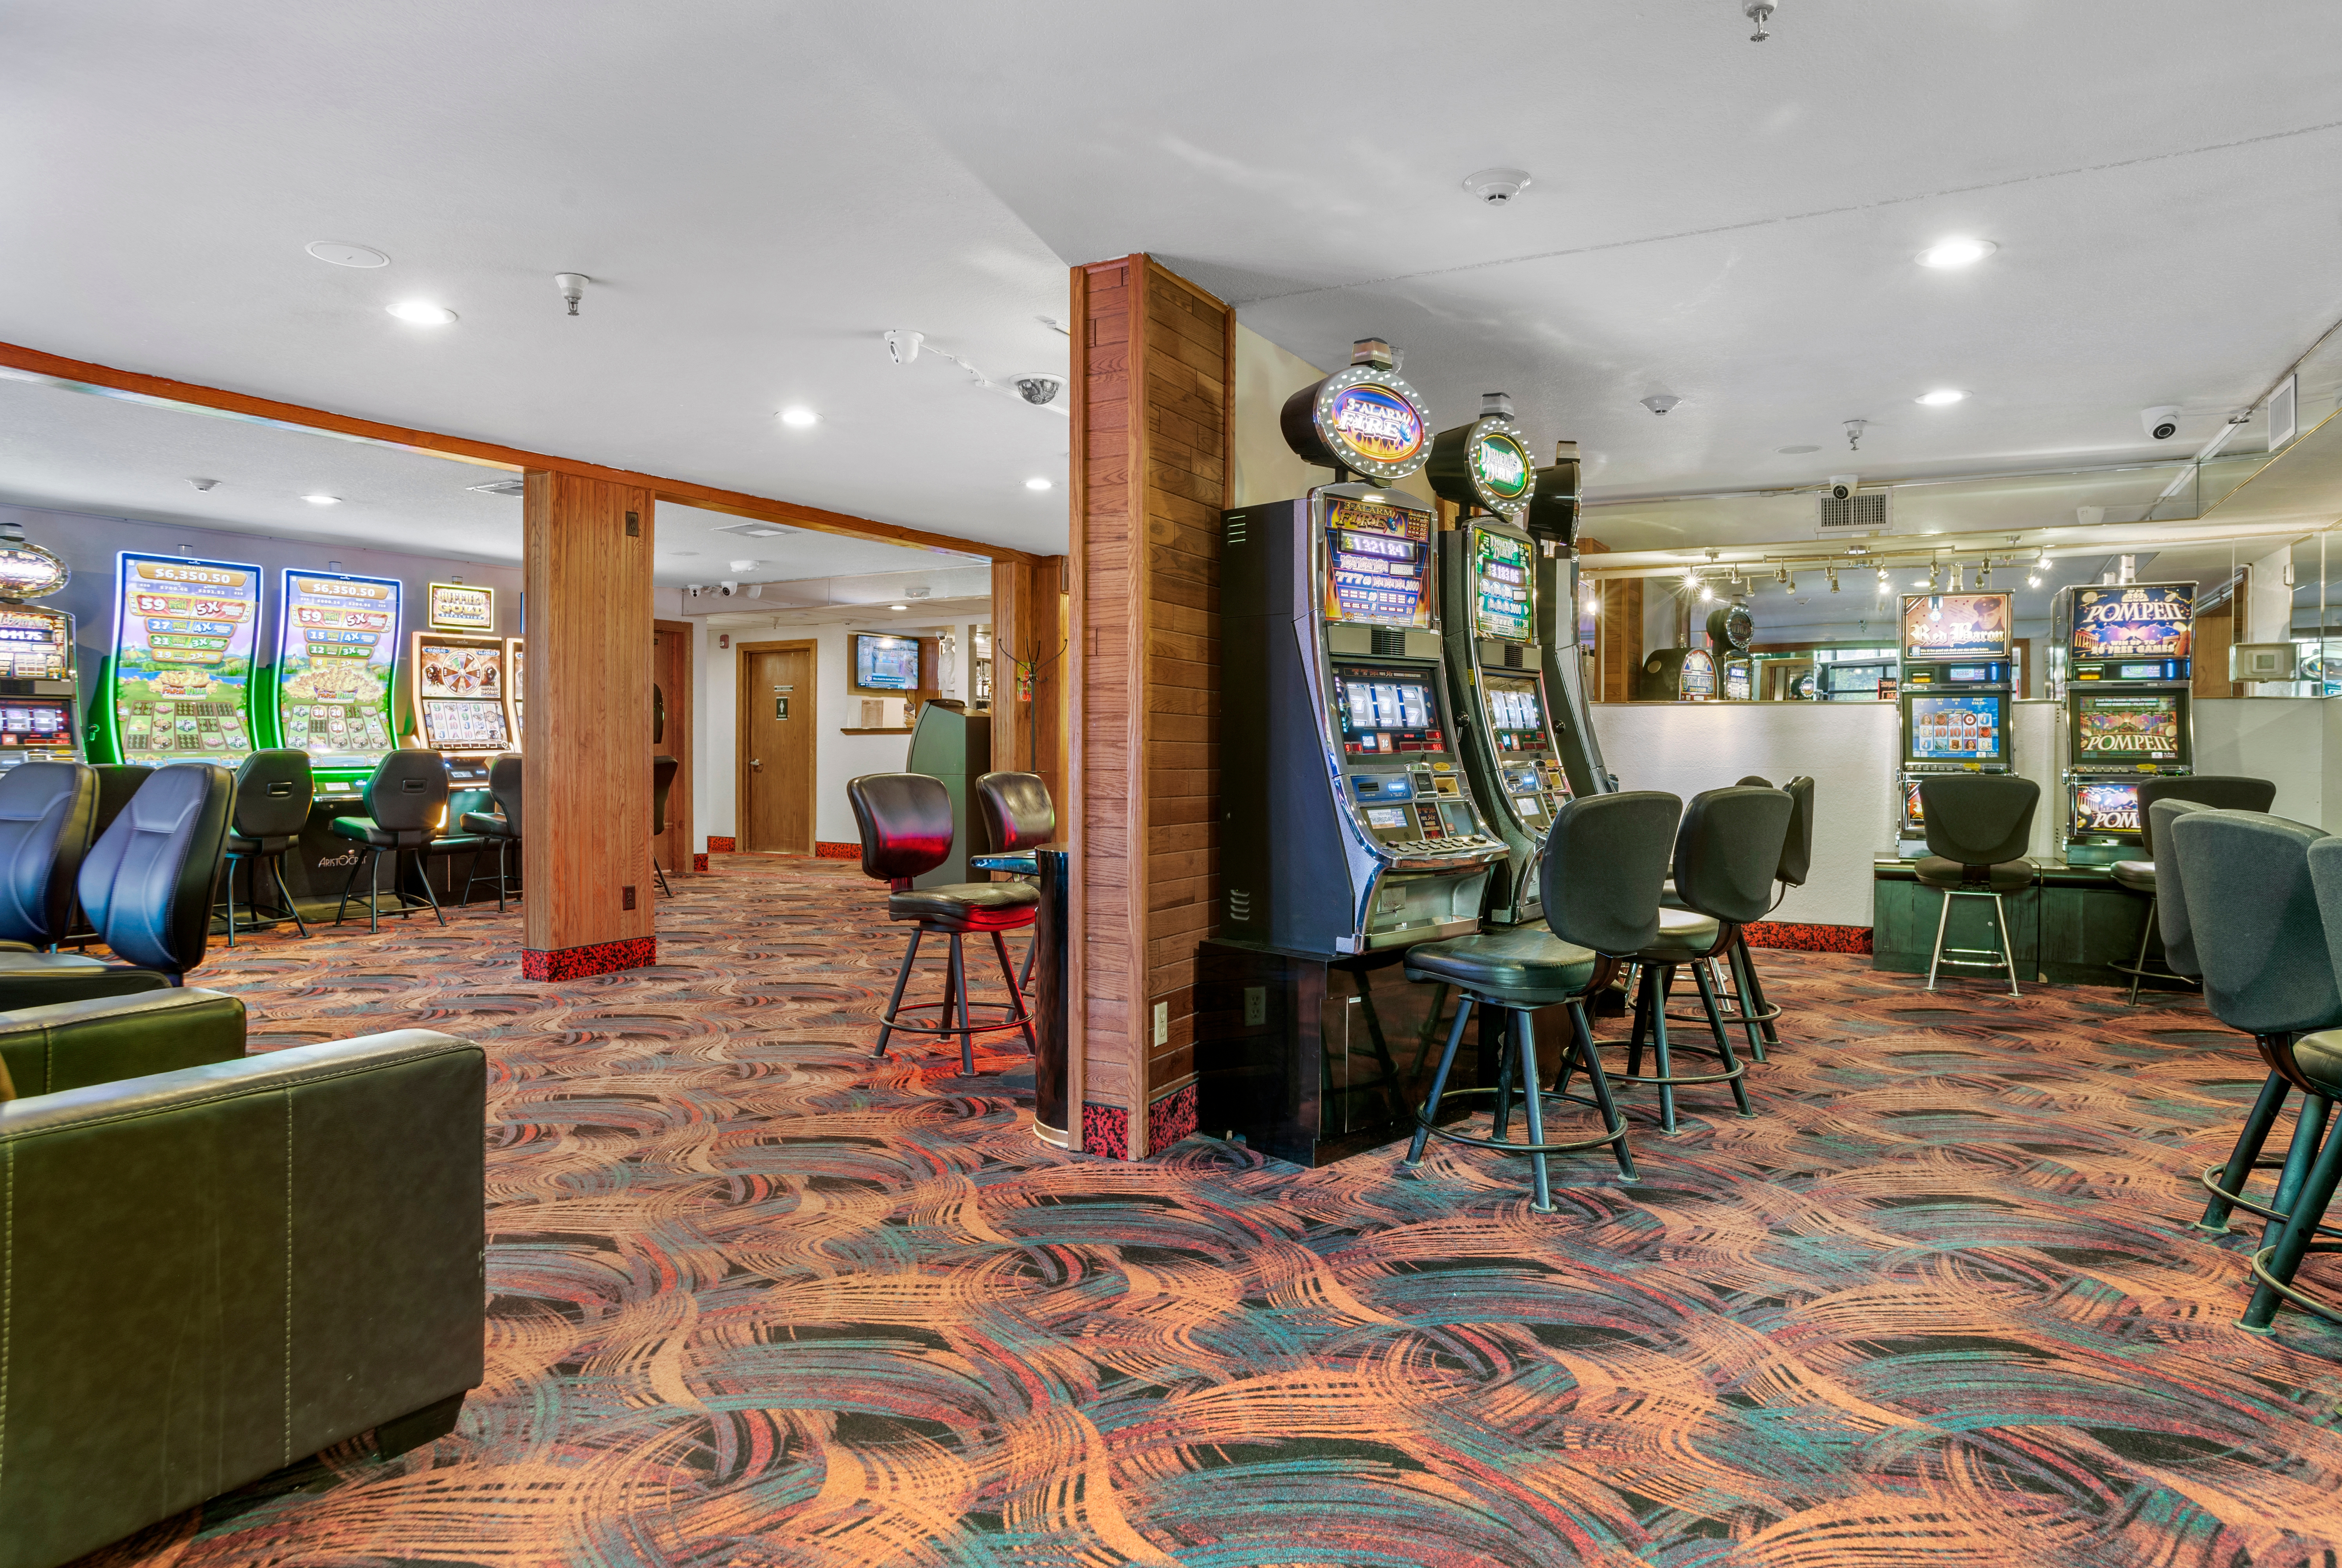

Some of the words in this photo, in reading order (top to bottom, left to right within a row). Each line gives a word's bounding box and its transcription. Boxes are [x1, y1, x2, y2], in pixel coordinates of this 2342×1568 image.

[1347, 398, 1408, 424] 3-ALARM
[1337, 410, 1400, 439] FIRE
[1481, 442, 1517, 470] DIAMONDS
[1485, 464, 1514, 484] DUBLIN
[1344, 501, 1393, 517] 3-ALARM
[1335, 510, 1388, 530] FIRE
[1490, 534, 1514, 551] DIAMONDS
[1493, 546, 1512, 560] DUBLIN
[155, 568, 231, 584] $6,350.50
[1391, 564, 1414, 575] PROGRESSIVE
[313, 583, 375, 597] $6,350.50
[1405, 580, 1419, 591] 3000
[438, 591, 486, 604] BUFFALO
[1368, 592, 1377, 601] 20
[141, 597, 166, 611] 59
[438, 602, 485, 616] GOLD
[1510, 603, 1521, 615] 3000
[301, 611, 322, 622] 59
[2081, 602, 2187, 623] POMPEII
[9, 618, 51, 629] ZONE
[152, 621, 170, 630] 27
[153, 637, 169, 645] 21
[310, 631, 324, 640] 15
[2108, 646, 2134, 654] FREE
[2136, 645, 2175, 653] GAMES
[1934, 727, 1947, 737] 10
[1949, 727, 1962, 737] 10
[1964, 727, 1976, 737] 10
[2084, 734, 2173, 751] POMPEII
[318, 855, 367, 868] ARISTOCRT
